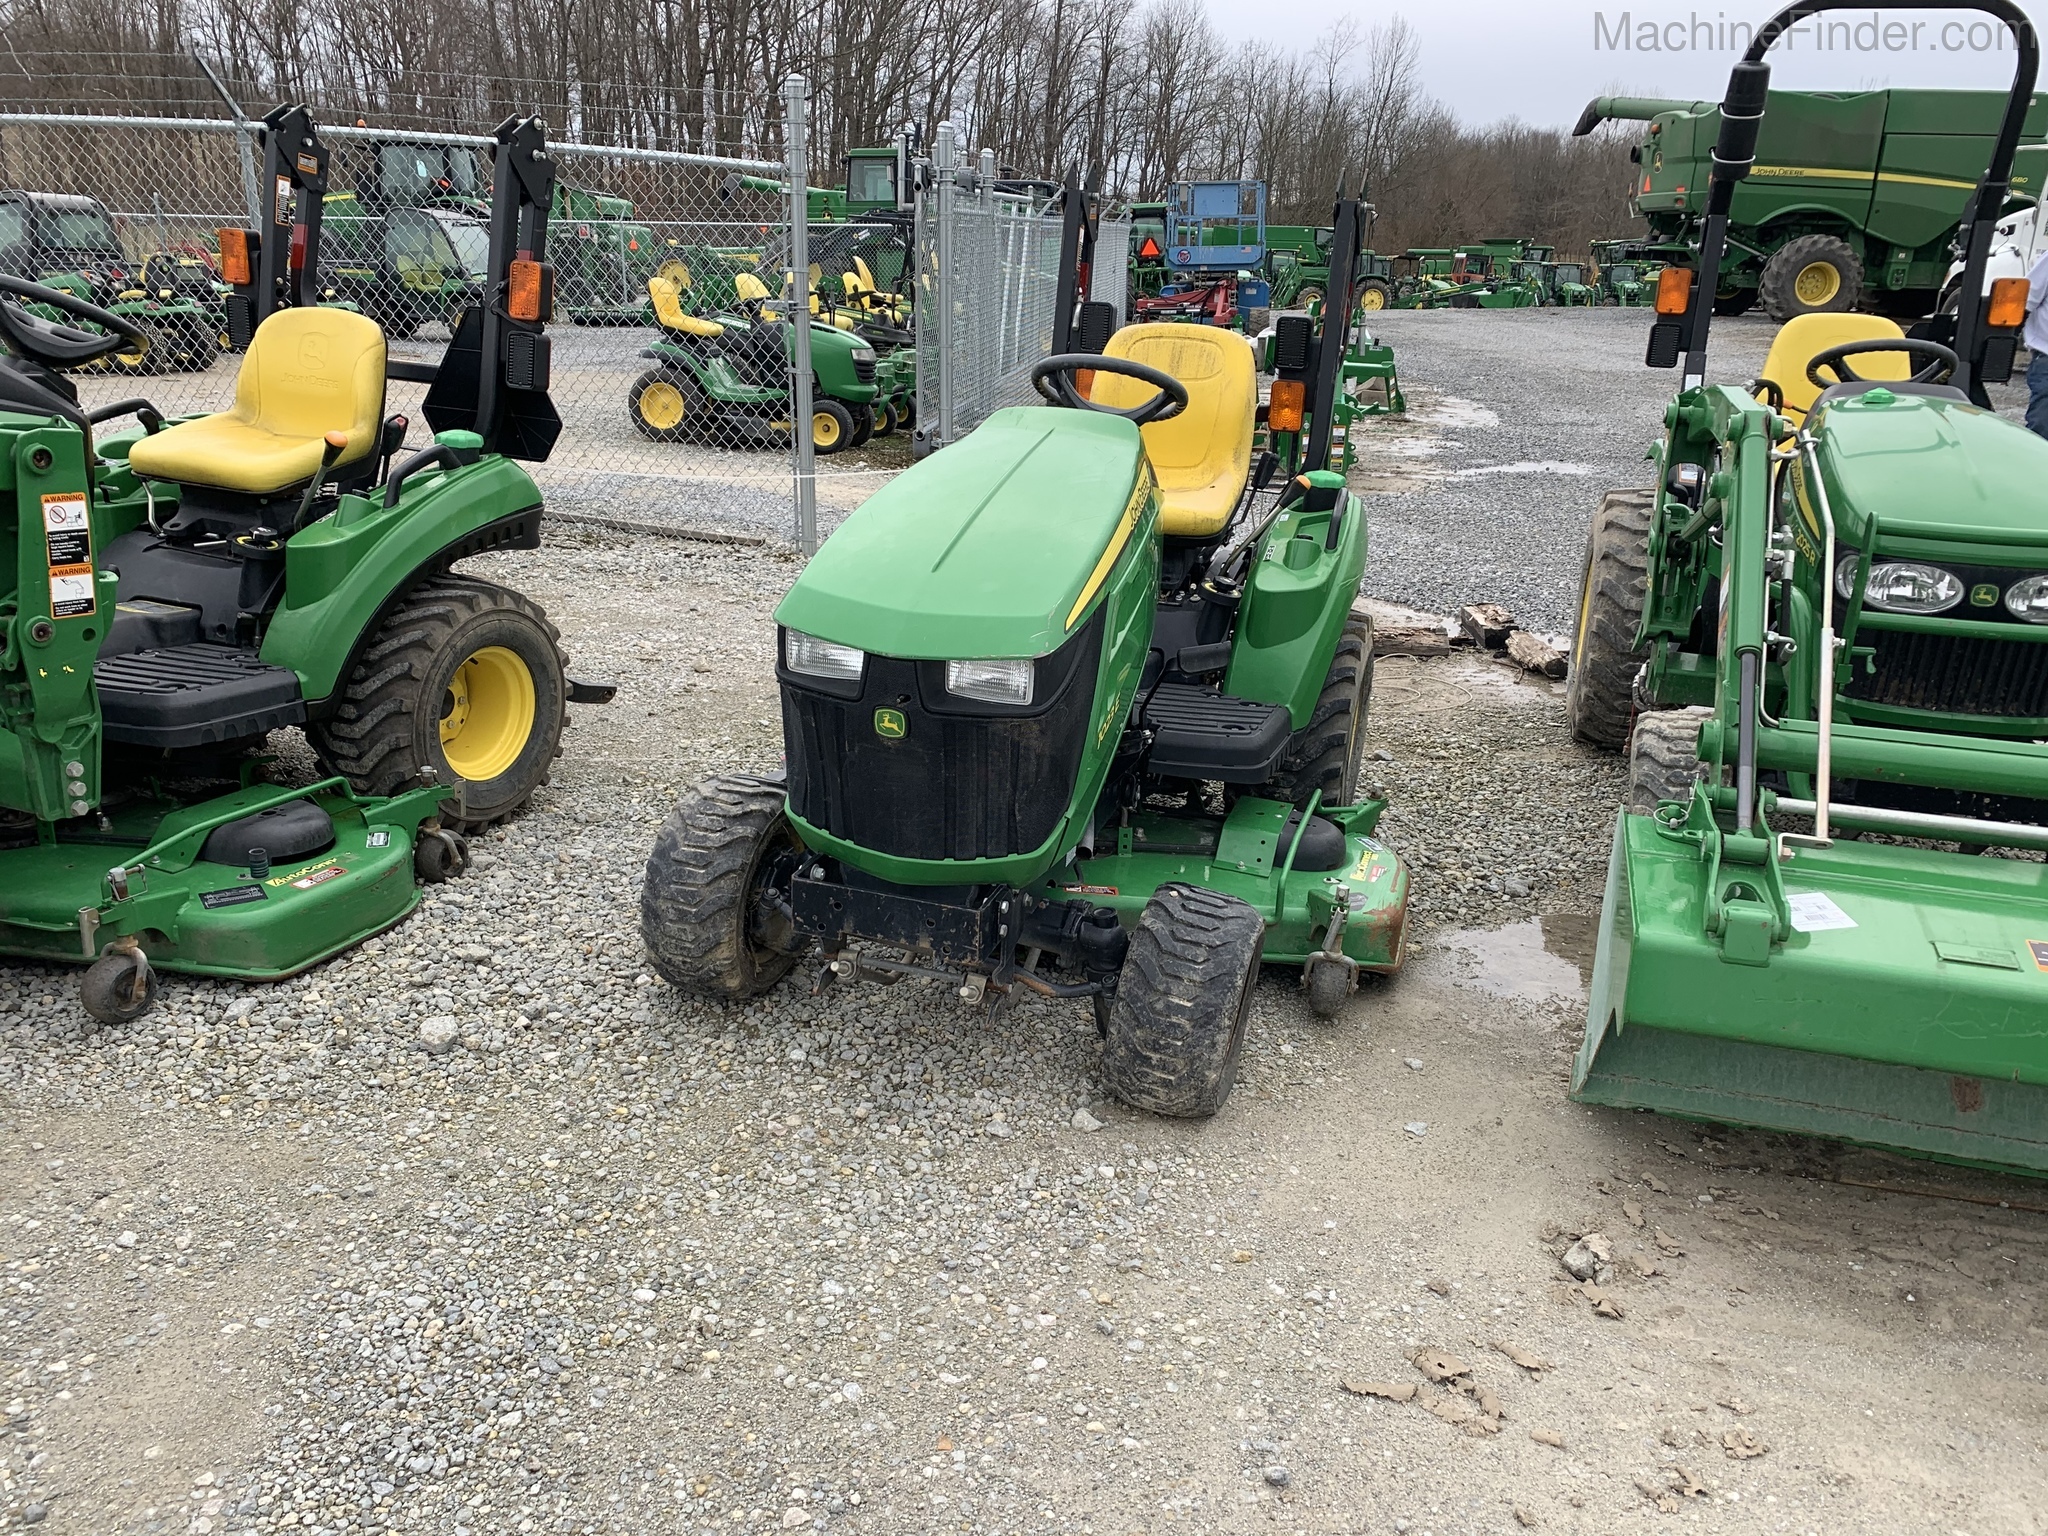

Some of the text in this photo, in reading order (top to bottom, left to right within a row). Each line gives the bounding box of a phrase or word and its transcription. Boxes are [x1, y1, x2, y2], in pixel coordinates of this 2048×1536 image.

[1755, 168, 1804, 177] JOHN DEERE
[281, 372, 339, 389] JOHN DEERE
[49, 494, 84, 502] WARNING
[57, 566, 91, 576] WARNING
